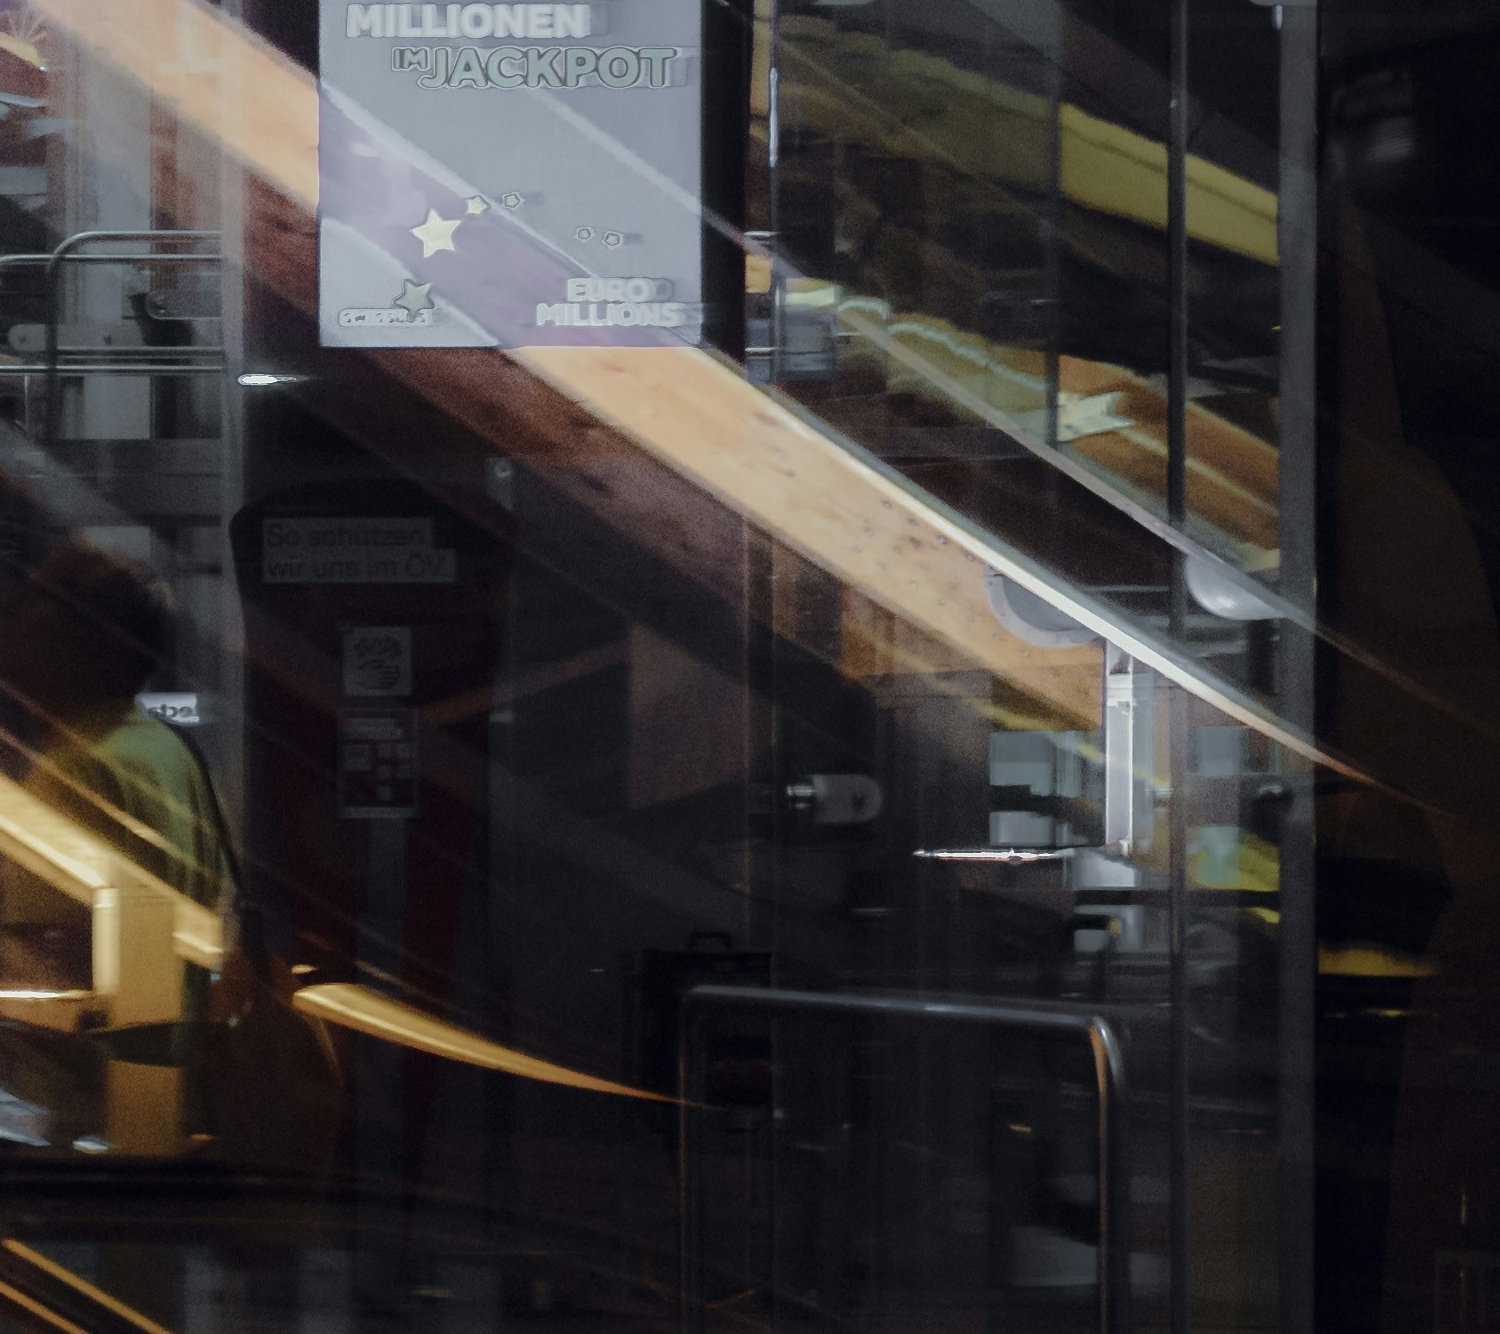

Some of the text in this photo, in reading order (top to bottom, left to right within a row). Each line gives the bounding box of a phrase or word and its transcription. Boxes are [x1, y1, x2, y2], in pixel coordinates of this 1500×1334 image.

[347, 3, 591, 38] MILLIONEN
[417, 47, 678, 88] JACKPOT
[567, 278, 658, 303] EURO
[536, 302, 686, 328] MILLIONS
